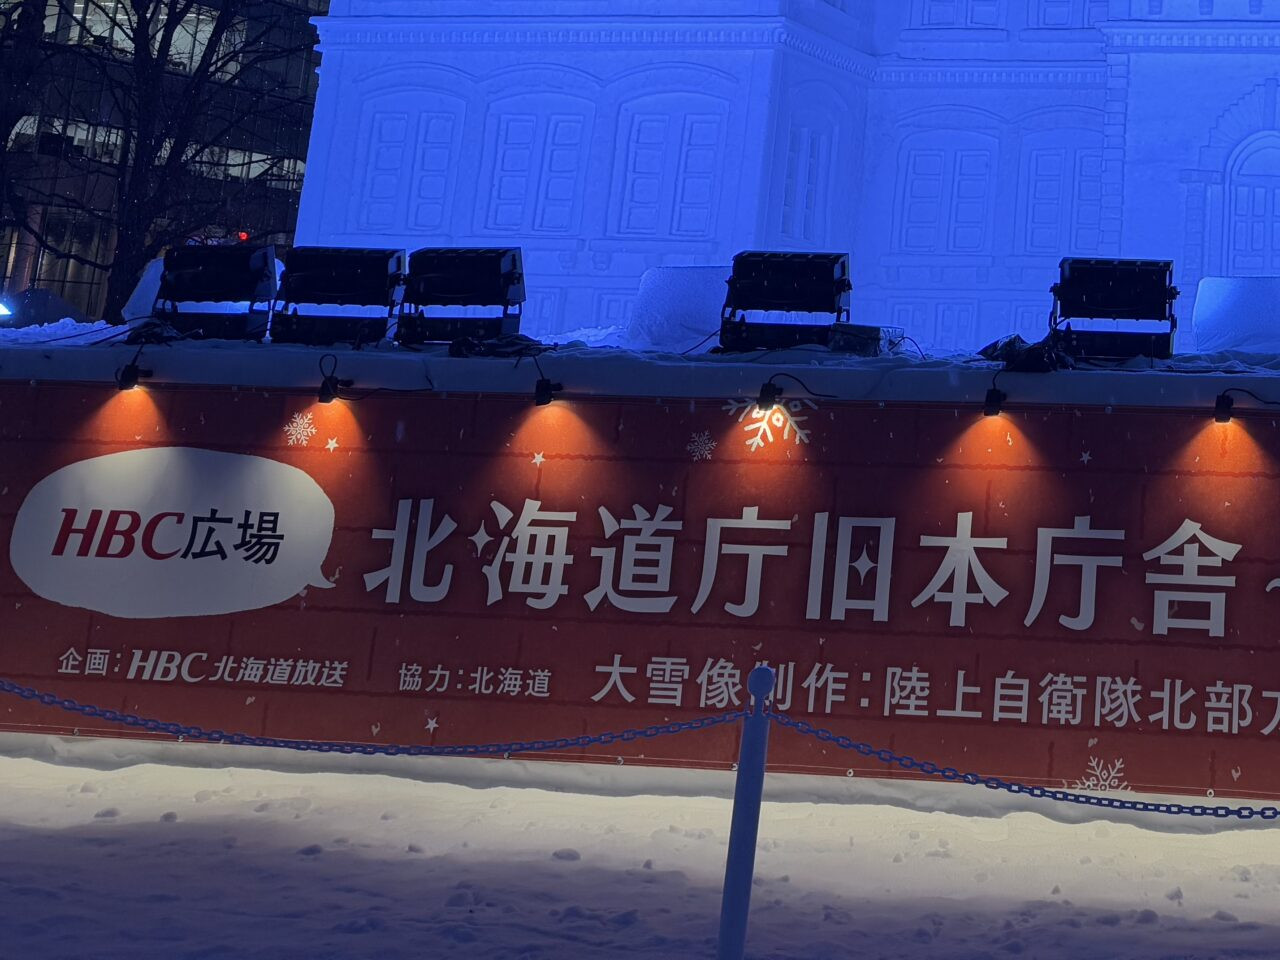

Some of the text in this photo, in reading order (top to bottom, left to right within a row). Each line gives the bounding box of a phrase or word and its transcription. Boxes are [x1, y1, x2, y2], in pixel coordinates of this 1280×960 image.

[51, 507, 285, 565] HBC広場
[364, 497, 1243, 637] 北海道庁旧本庁舎
